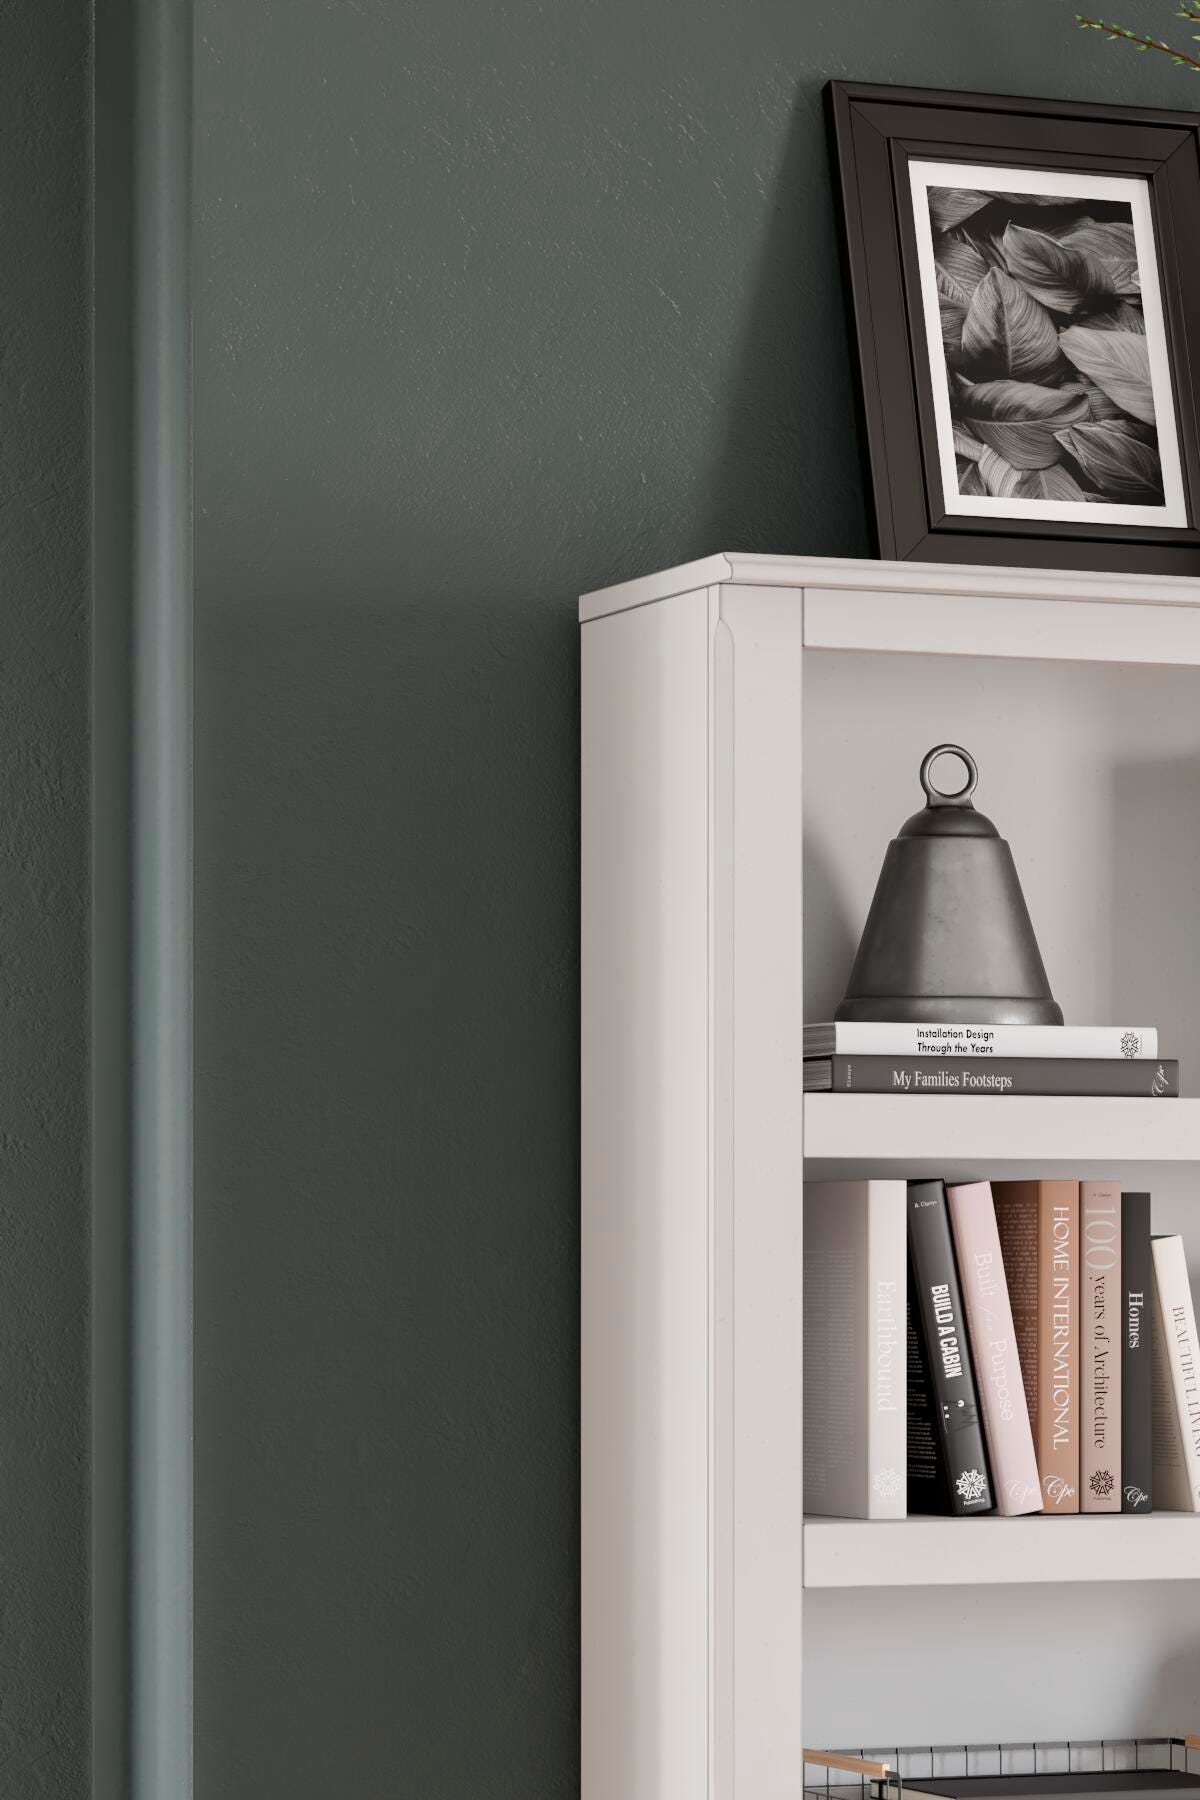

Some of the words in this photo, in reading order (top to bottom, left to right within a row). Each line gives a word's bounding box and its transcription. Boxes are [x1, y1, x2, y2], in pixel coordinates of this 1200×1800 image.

[917, 1028, 964, 1039] Installation
[966, 1029, 994, 1042] Design
[917, 1042, 951, 1055] Through
[954, 1043, 968, 1053] the
[970, 1043, 994, 1054] Years
[893, 1070, 911, 1090] My
[915, 1071, 960, 1088] Families
[963, 1072, 1013, 1091] Footsteps
[1053, 1207, 1070, 1271] HOME
[1085, 1207, 1117, 1271] 100
[931, 1283, 954, 1324] BUILD
[1089, 1275, 1106, 1320] years
[1128, 1290, 1144, 1349] Homes
[877, 1280, 897, 1412] Earthbound
[938, 1326, 956, 1337] A
[974, 1253, 998, 1297] Built
[990, 1340, 1014, 1423] Purpose
[1094, 1325, 1110, 1343] of
[1172, 1305, 1197, 1399] BEAUTIFUL
[940, 1337, 963, 1379] CABIN
[1053, 1278, 1070, 1451] INTERNATIONAL
[1094, 1346, 1111, 1449] Architecture
